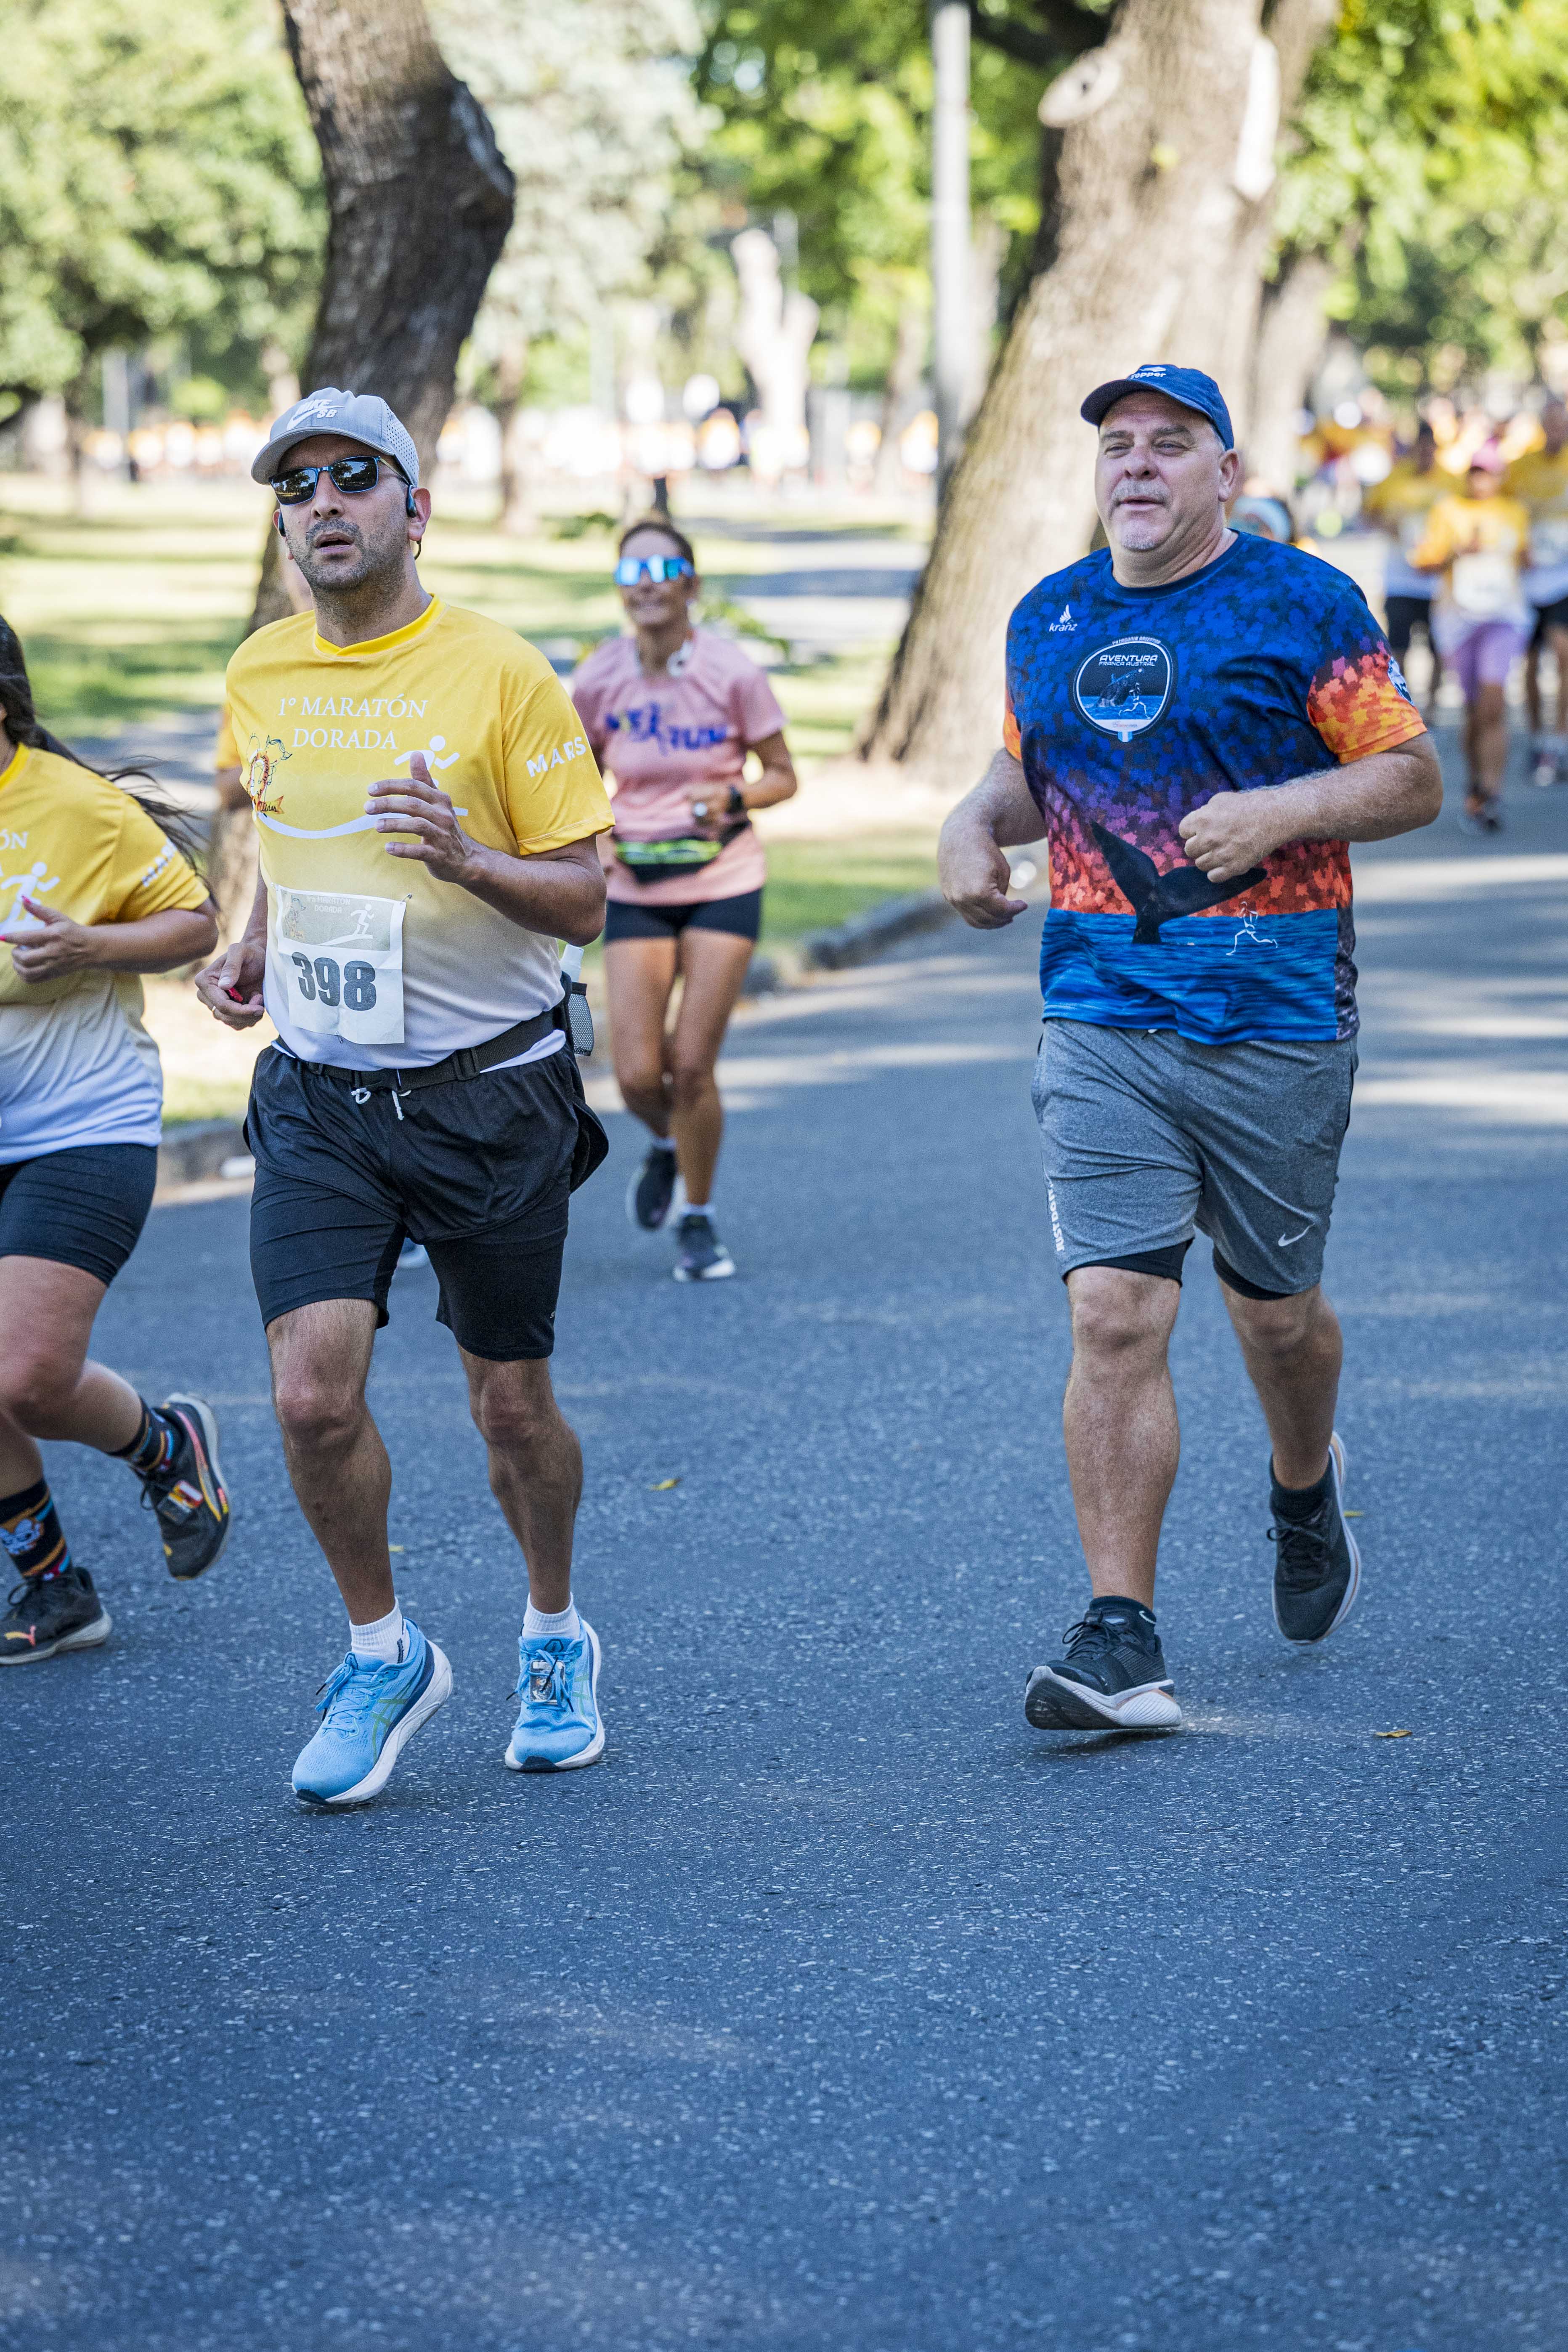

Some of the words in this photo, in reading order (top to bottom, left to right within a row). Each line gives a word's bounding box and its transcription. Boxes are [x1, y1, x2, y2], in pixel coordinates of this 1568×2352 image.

[294, 399, 333, 417] NIKE
[317, 409, 338, 419] SB
[300, 693, 428, 718] MARATÓN
[292, 728, 398, 749] DORADA
[526, 736, 586, 778] MARS
[292, 951, 377, 1011] 398
[1052, 1222, 1065, 1252] JUST
